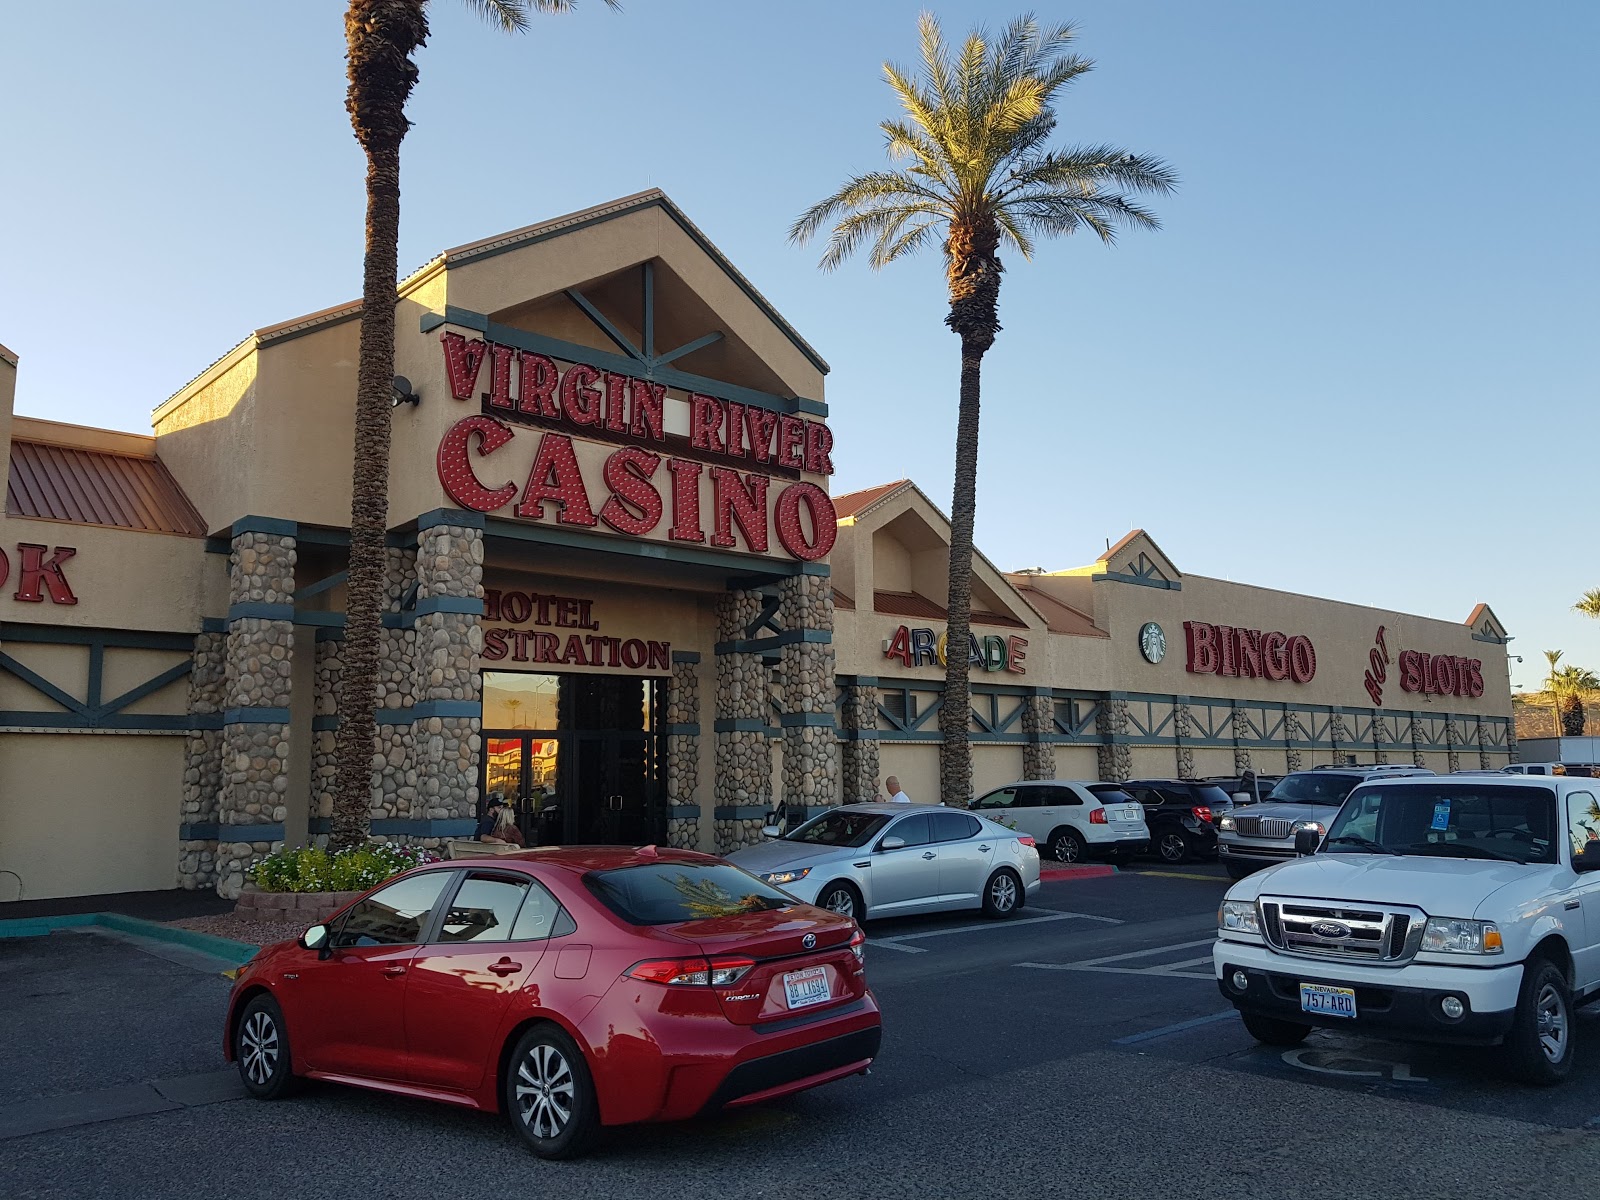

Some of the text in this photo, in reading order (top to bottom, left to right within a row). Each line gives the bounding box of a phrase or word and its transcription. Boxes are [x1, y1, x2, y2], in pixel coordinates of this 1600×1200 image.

[440, 331, 835, 476] VIRGIN RIVER
[437, 414, 838, 562] CASINO
[0, 542, 78, 605] K
[479, 627, 671, 671] STRATION
[1183, 620, 1317, 684] BINGO
[1364, 625, 1390, 707] HOT
[1400, 649, 1485, 698] SLOTS
[1318, 923, 1341, 936] Ford
[725, 993, 760, 1002] COROLLA
[1314, 986, 1341, 995] NEVADA
